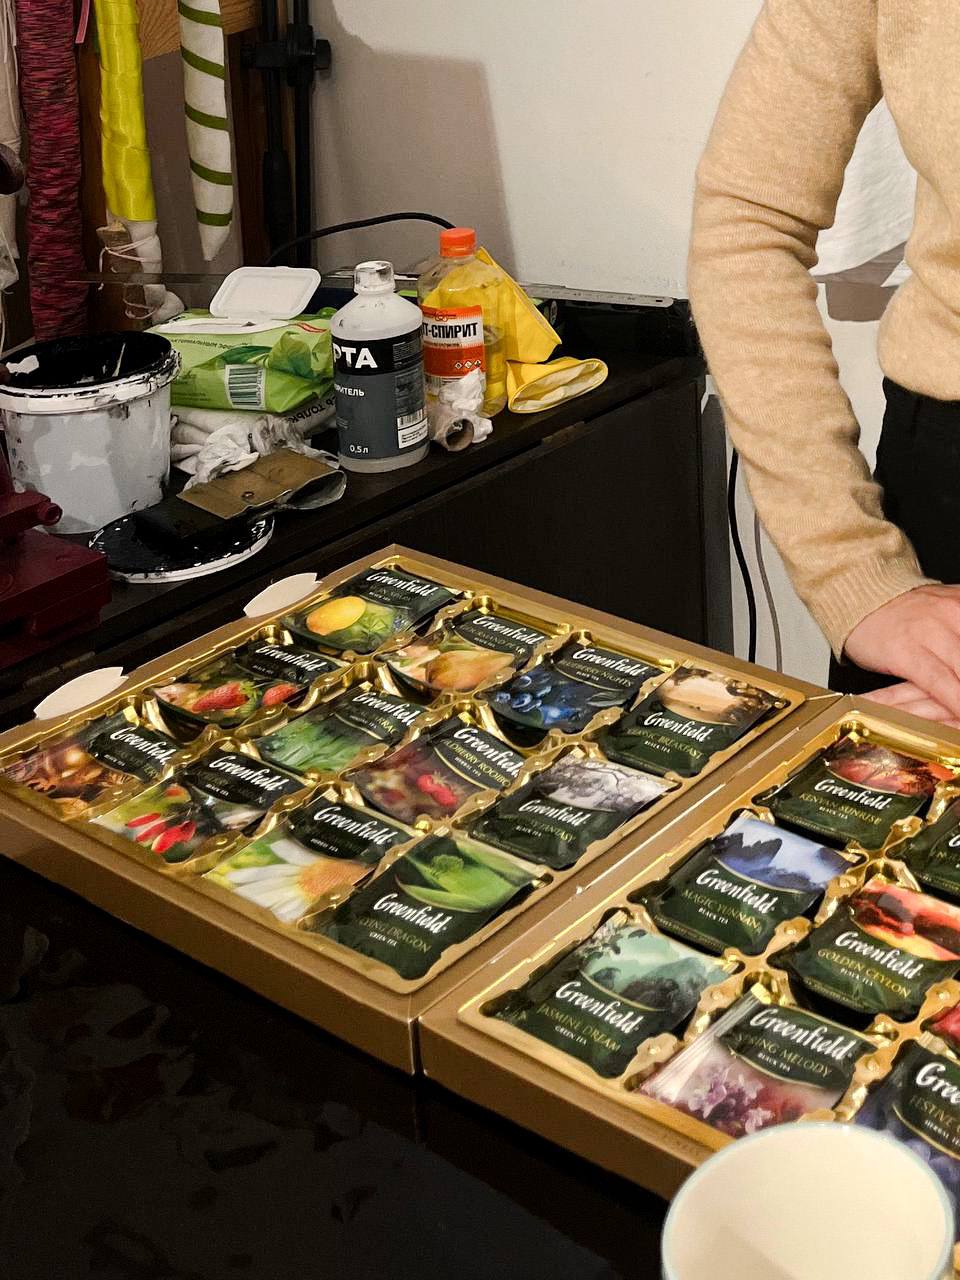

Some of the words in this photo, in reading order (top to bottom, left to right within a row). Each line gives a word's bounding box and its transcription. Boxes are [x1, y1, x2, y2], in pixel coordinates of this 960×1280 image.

[332, 342, 378, 369] РТА
[366, 572, 439, 596] Greenfield
[472, 616, 544, 644] Greenfield
[255, 645, 327, 671] Greenfield
[573, 648, 649, 676] Greenfield
[644, 712, 714, 742] Greenfield
[209, 755, 289, 791] Greenfield
[478, 762, 511, 787] ROOIBO
[814, 779, 892, 810] Greenfield
[313, 806, 398, 845] Greenfield
[518, 799, 592, 827] Greenfield
[839, 805, 882, 825] SUNRISE
[696, 869, 778, 914] Greenfield
[373, 893, 453, 934] Greenfield
[387, 927, 431, 953] DRAGON
[835, 931, 924, 979] Greenfield
[817, 948, 865, 972] GOLDEN
[866, 968, 912, 999] CEYLON
[555, 981, 644, 1034] Greenfield
[536, 1003, 582, 1030] JASMINE
[582, 1025, 621, 1052] DREAM
[750, 1008, 856, 1061] Greenfield
[735, 1033, 779, 1054] RING
[780, 1049, 832, 1078] MELODY
